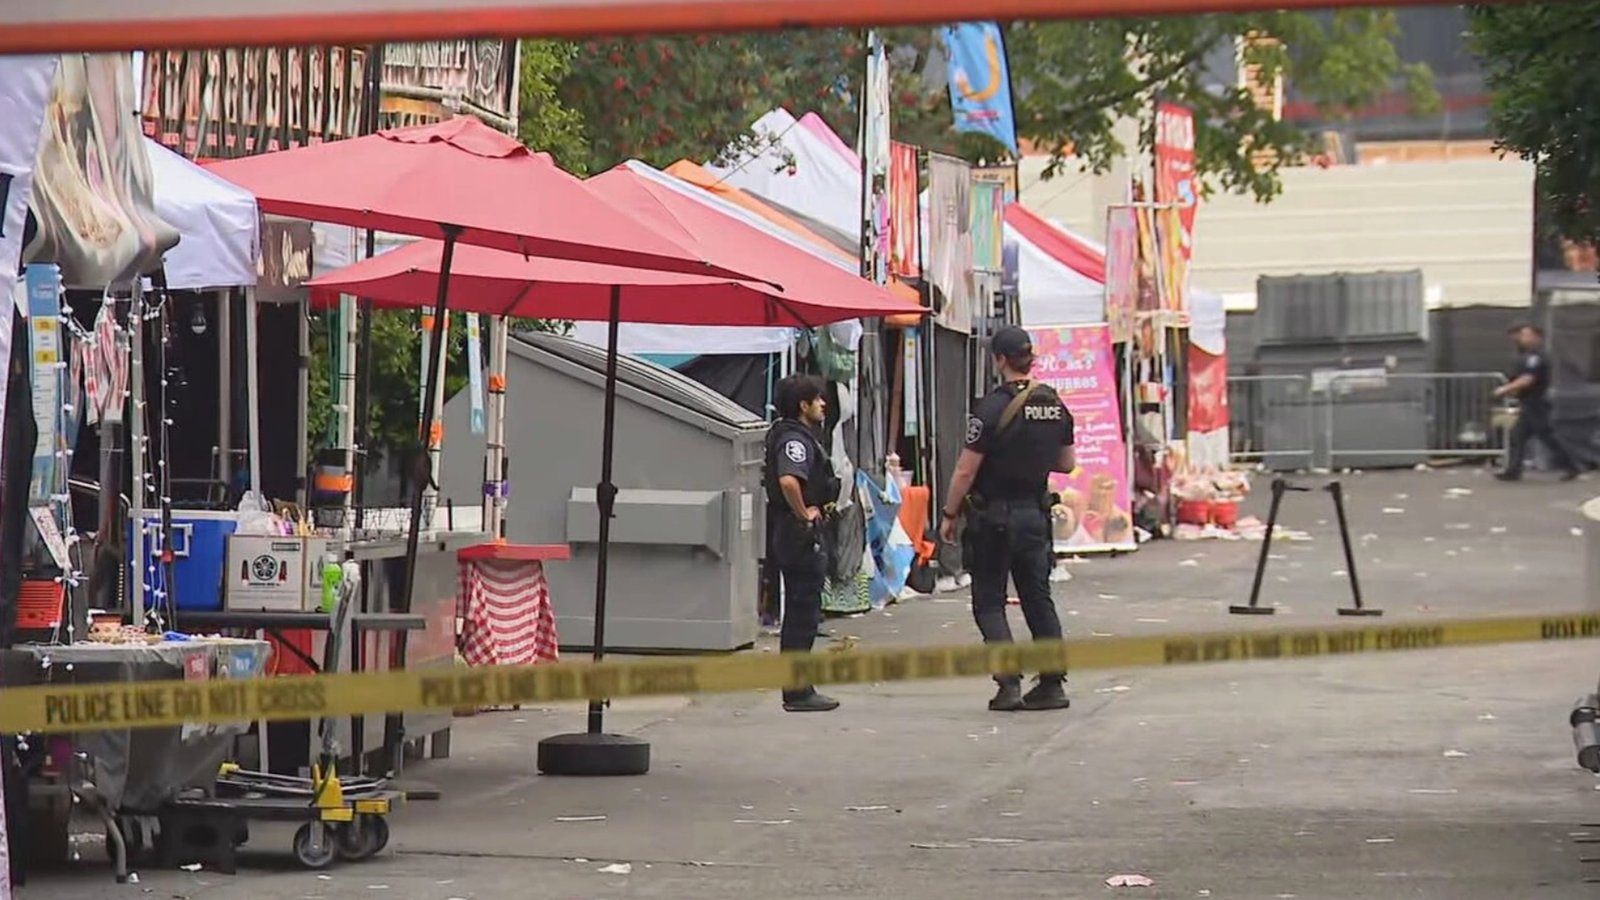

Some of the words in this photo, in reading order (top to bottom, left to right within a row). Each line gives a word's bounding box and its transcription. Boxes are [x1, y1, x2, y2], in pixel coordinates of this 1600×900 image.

[1024, 405, 1061, 420] POLICE
[45, 692, 120, 725] POLICE
[123, 687, 166, 720] LINE
[172, 684, 202, 717] DO
[208, 683, 249, 716] NOT
[257, 680, 327, 713] CROSS
